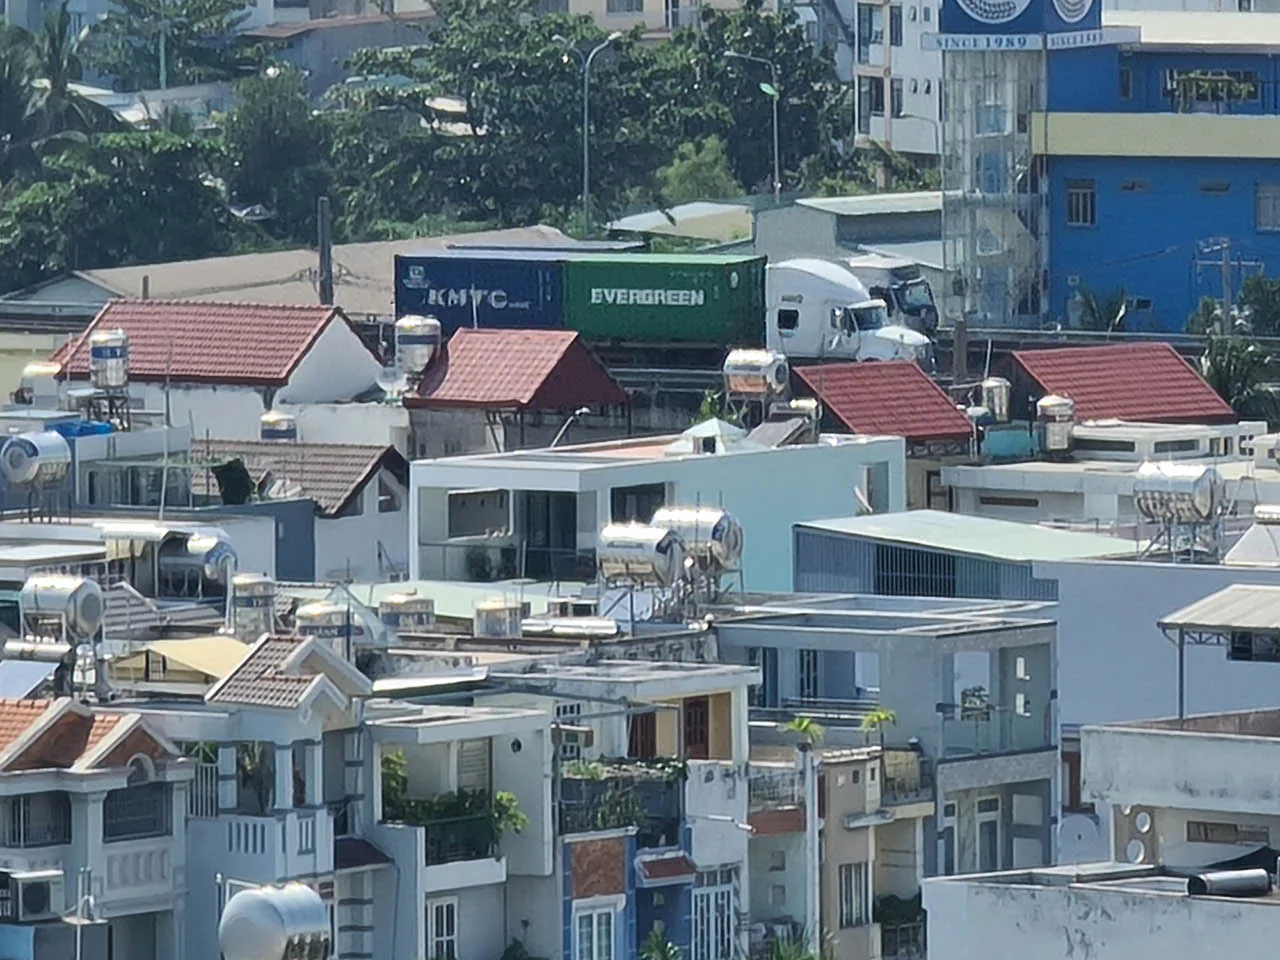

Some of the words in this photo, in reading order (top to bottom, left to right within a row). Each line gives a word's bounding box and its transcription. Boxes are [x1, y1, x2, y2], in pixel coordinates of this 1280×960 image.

[937, 37, 977, 48] SINCE
[426, 288, 508, 309] KMTC
[591, 288, 704, 306] EVERGREEN
